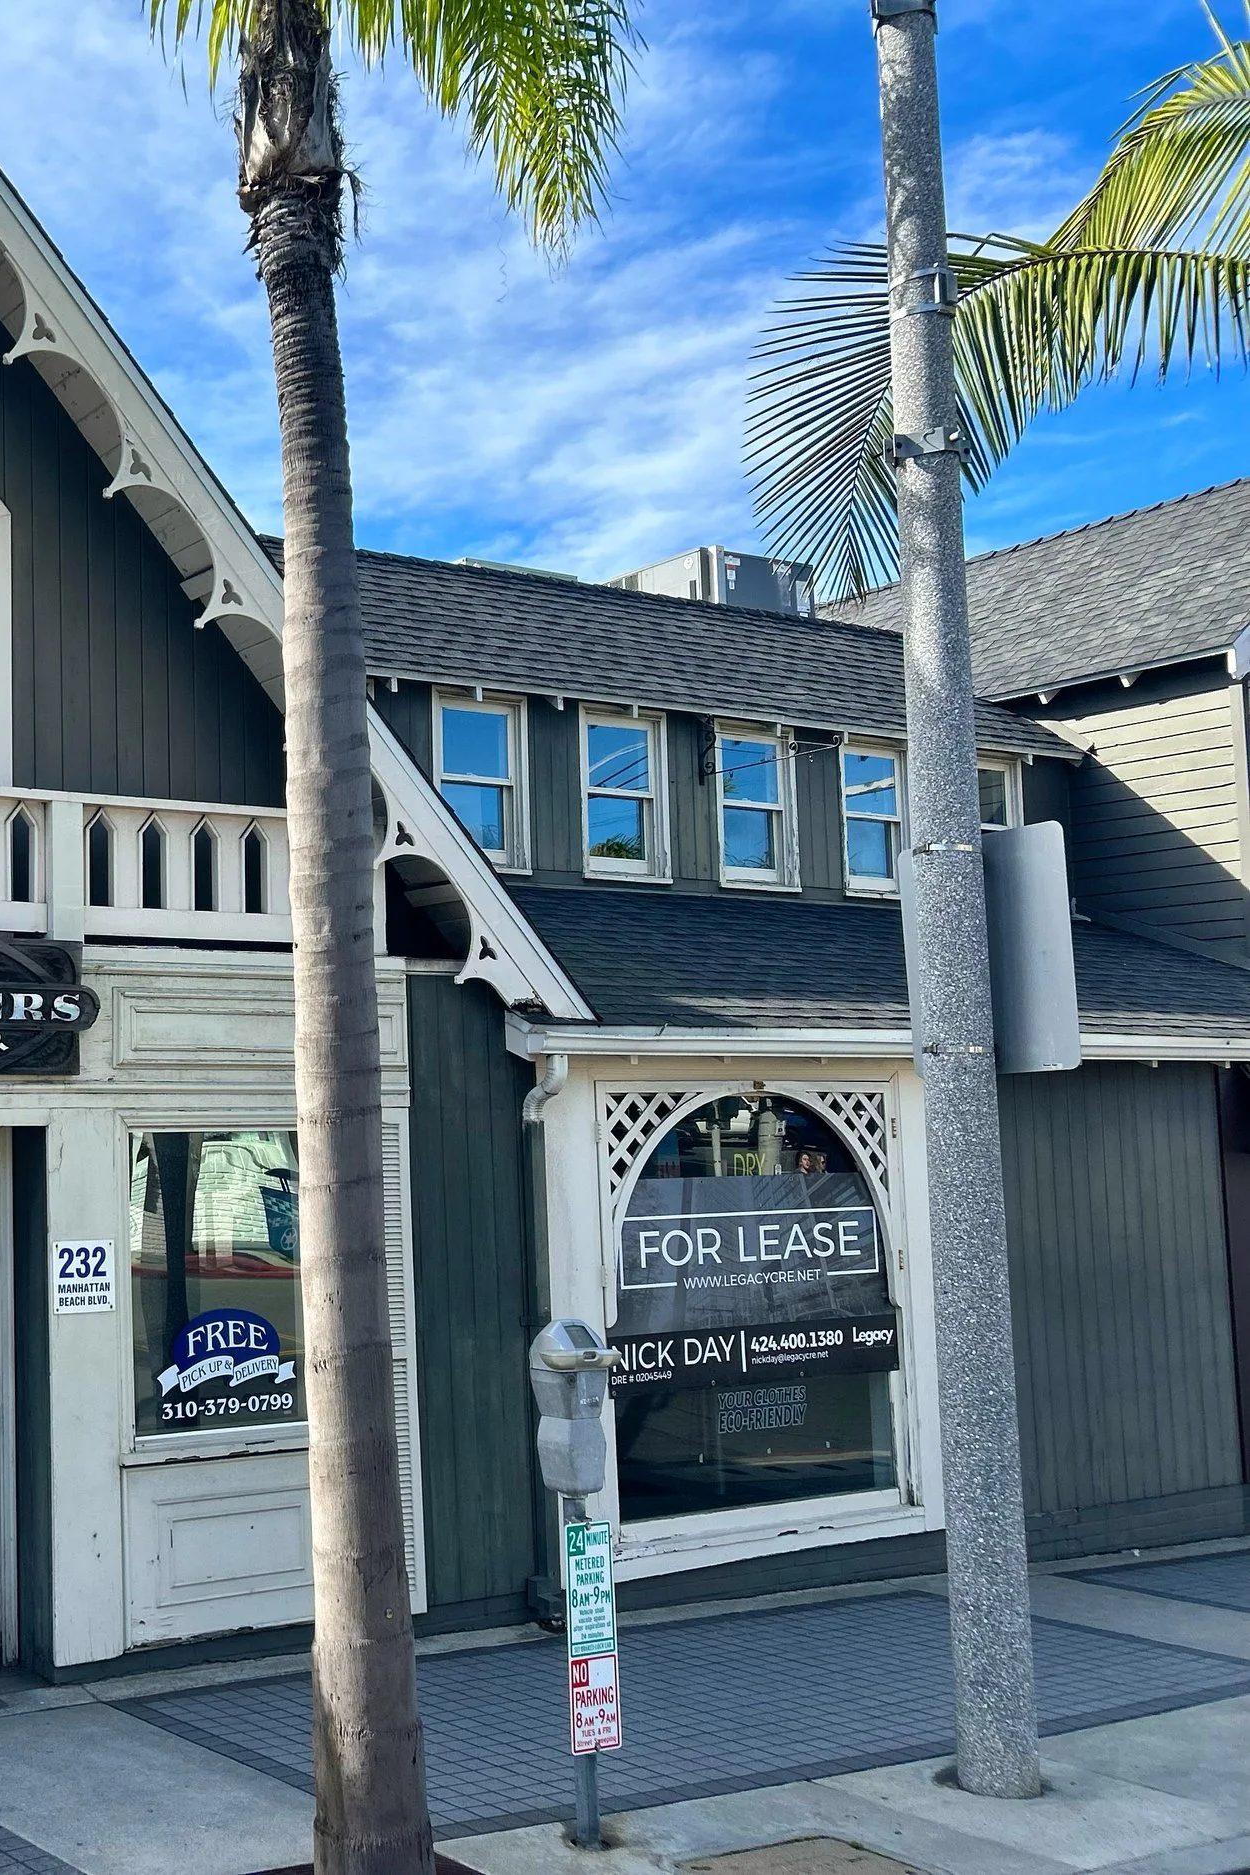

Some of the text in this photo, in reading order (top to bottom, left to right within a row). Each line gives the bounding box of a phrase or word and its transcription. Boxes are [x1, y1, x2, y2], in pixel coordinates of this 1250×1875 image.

[733, 1152, 766, 1176] DRY
[639, 1220, 861, 1269] FOR LEASE
[59, 1246, 107, 1278] 232
[58, 1282, 110, 1294] MANHATTAN
[683, 1268, 821, 1290] WWW.LEGACYCRE.NET
[59, 1295, 110, 1307] BEACH BLVD.
[187, 1320, 269, 1358] FREE
[750, 1326, 894, 1352] 424.400.1380 Legacy
[612, 1334, 735, 1372] NICK DAY
[751, 1350, 829, 1365] nickday@legacycre.net
[182, 1358, 278, 1389] PICK UP & DELIVERY
[611, 1371, 672, 1385] DRE # 02045449
[161, 1393, 293, 1420] 310-379-0799
[718, 1385, 806, 1409] YOUR CLOTHES
[718, 1403, 807, 1434] ECO-FRIENDLY
[569, 1531, 608, 1552] 24 MINUTE
[575, 1556, 604, 1571] METERED
[576, 1571, 605, 1586] PARKING
[572, 1663, 587, 1684] NO
[575, 1686, 614, 1709] PARKING
[582, 1729, 595, 1737] TUES
